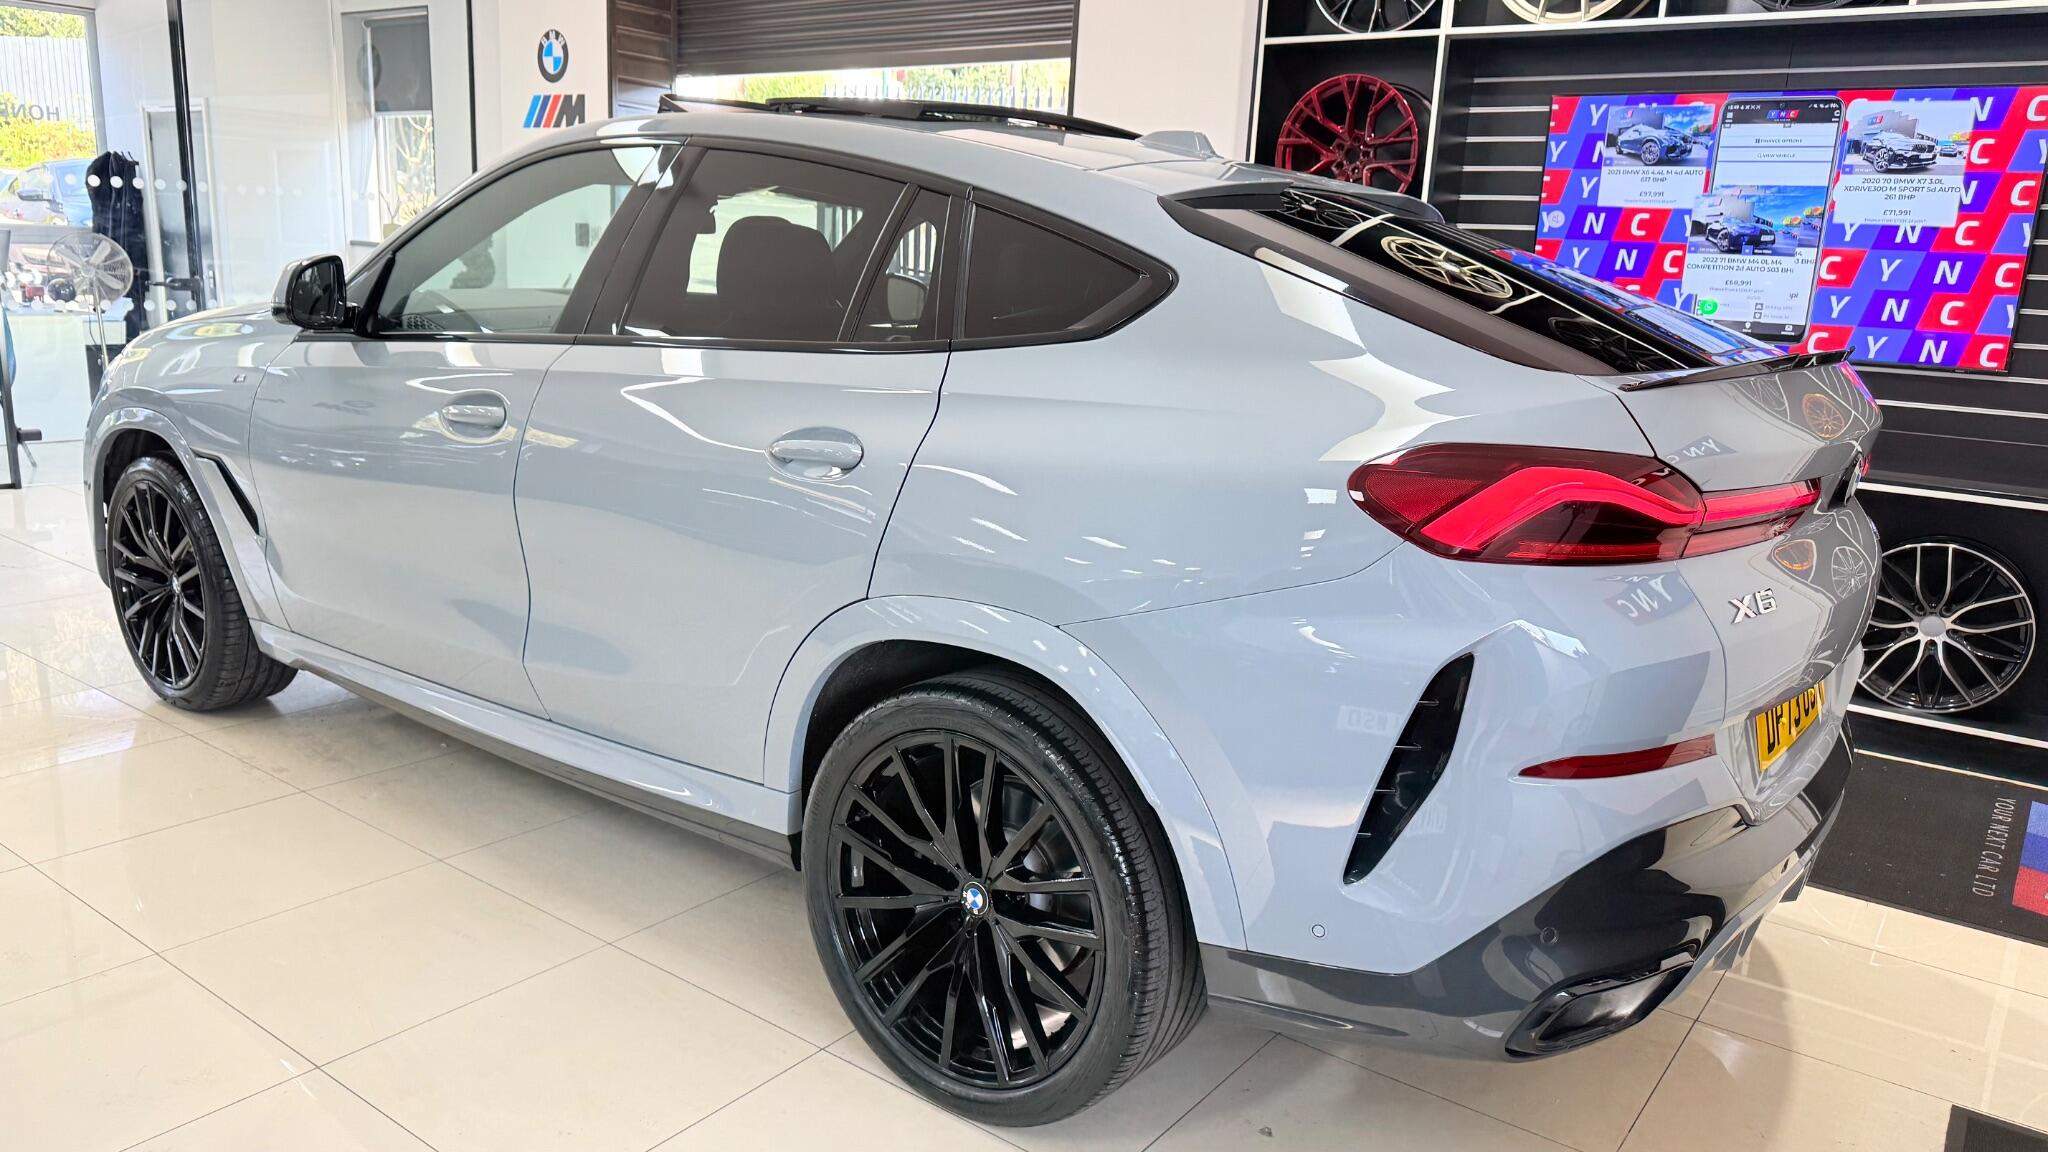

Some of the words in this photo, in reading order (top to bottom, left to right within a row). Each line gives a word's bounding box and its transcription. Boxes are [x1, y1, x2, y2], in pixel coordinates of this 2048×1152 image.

[1728, 587, 1778, 625] X6
[1991, 797, 2017, 822] YOUR
[1985, 822, 2010, 850] NEXT
[1977, 850, 2003, 873] CAR
[1972, 873, 1998, 898] LTD
